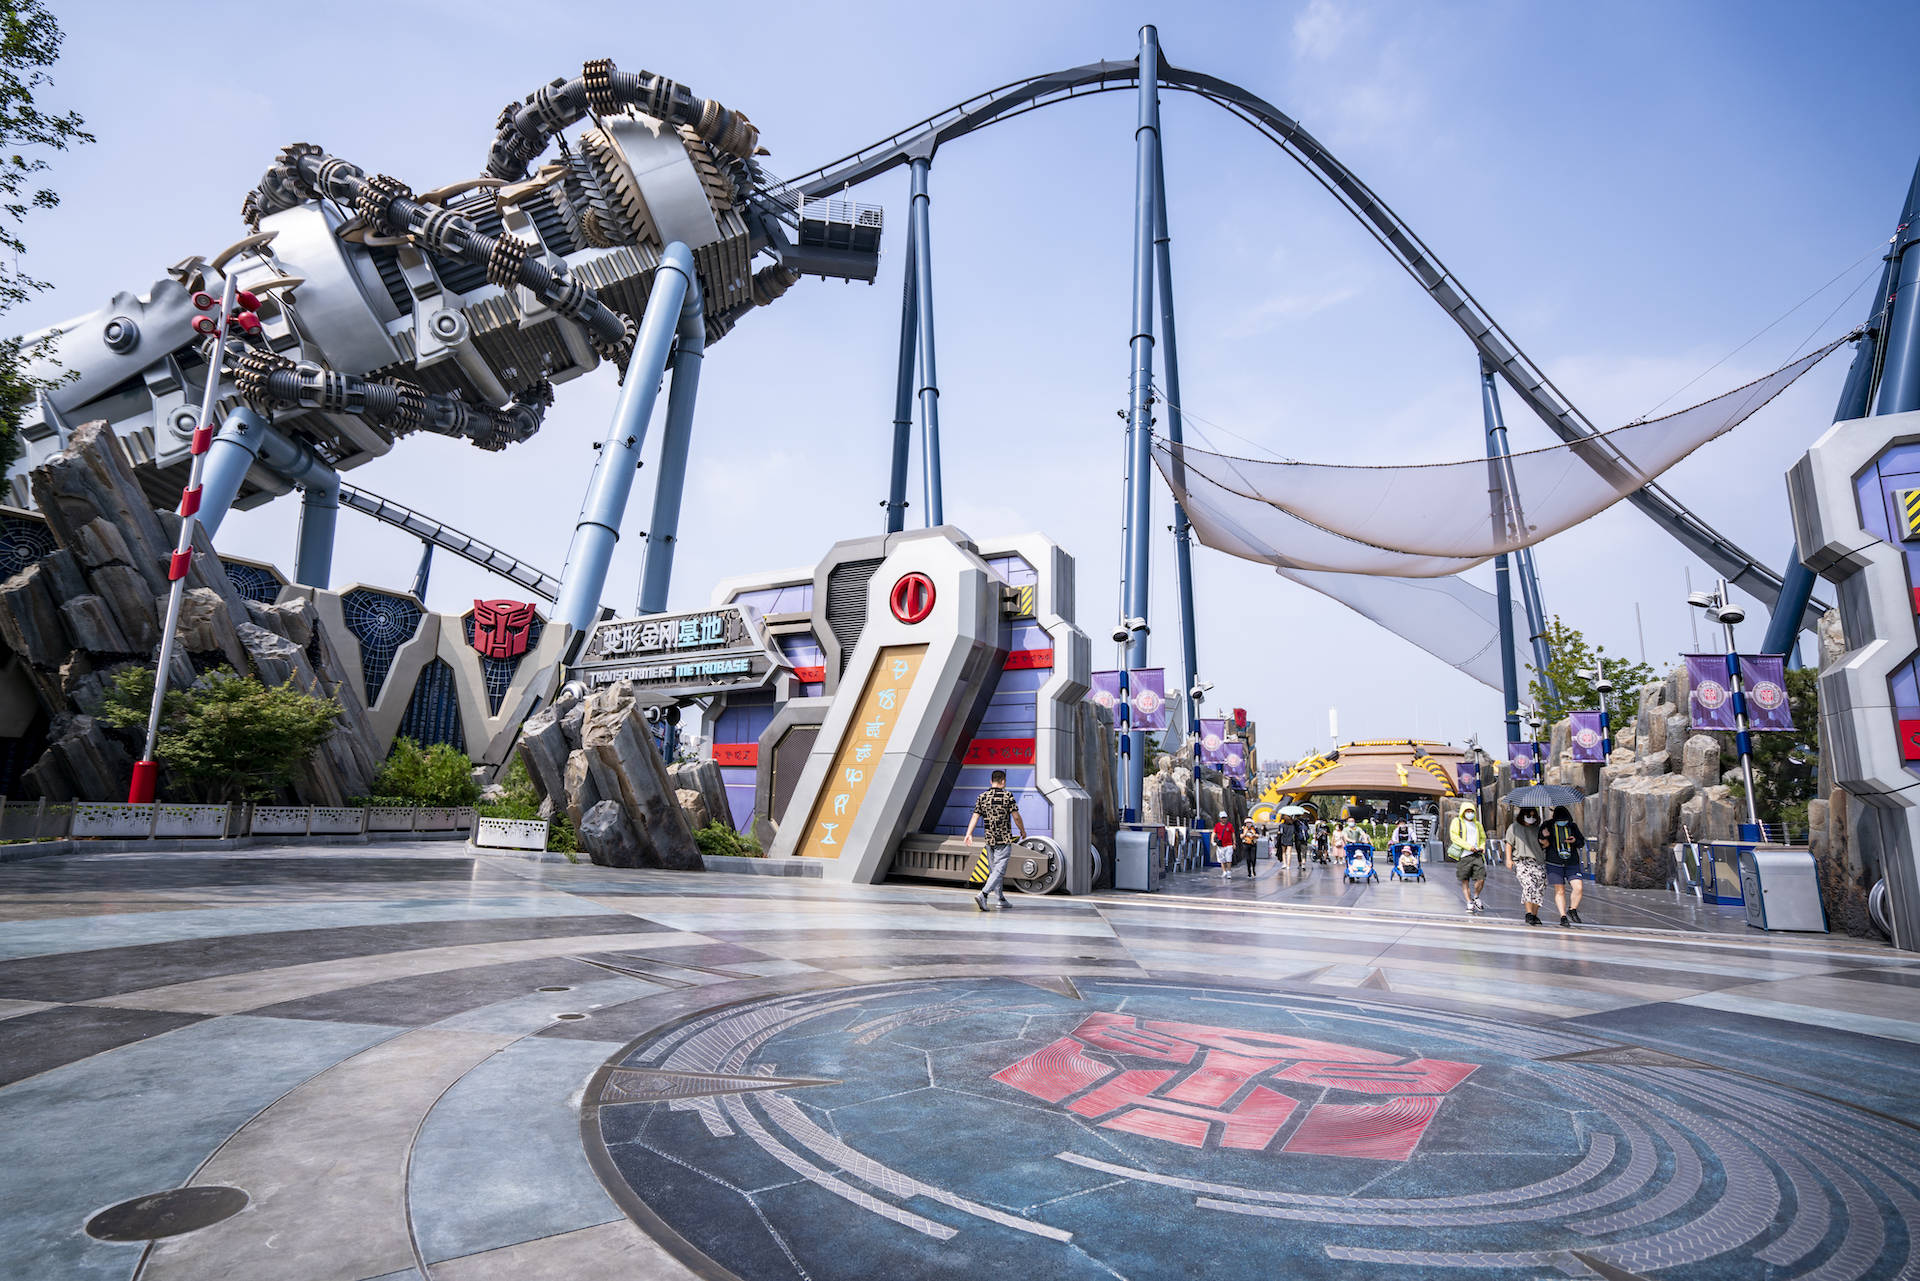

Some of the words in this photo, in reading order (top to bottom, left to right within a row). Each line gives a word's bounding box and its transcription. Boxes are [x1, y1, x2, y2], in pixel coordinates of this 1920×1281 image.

[601, 616, 724, 654] 变形金刚基地
[590, 665, 673, 688] TRANSFORMERS
[675, 659, 749, 677] METROBASE
